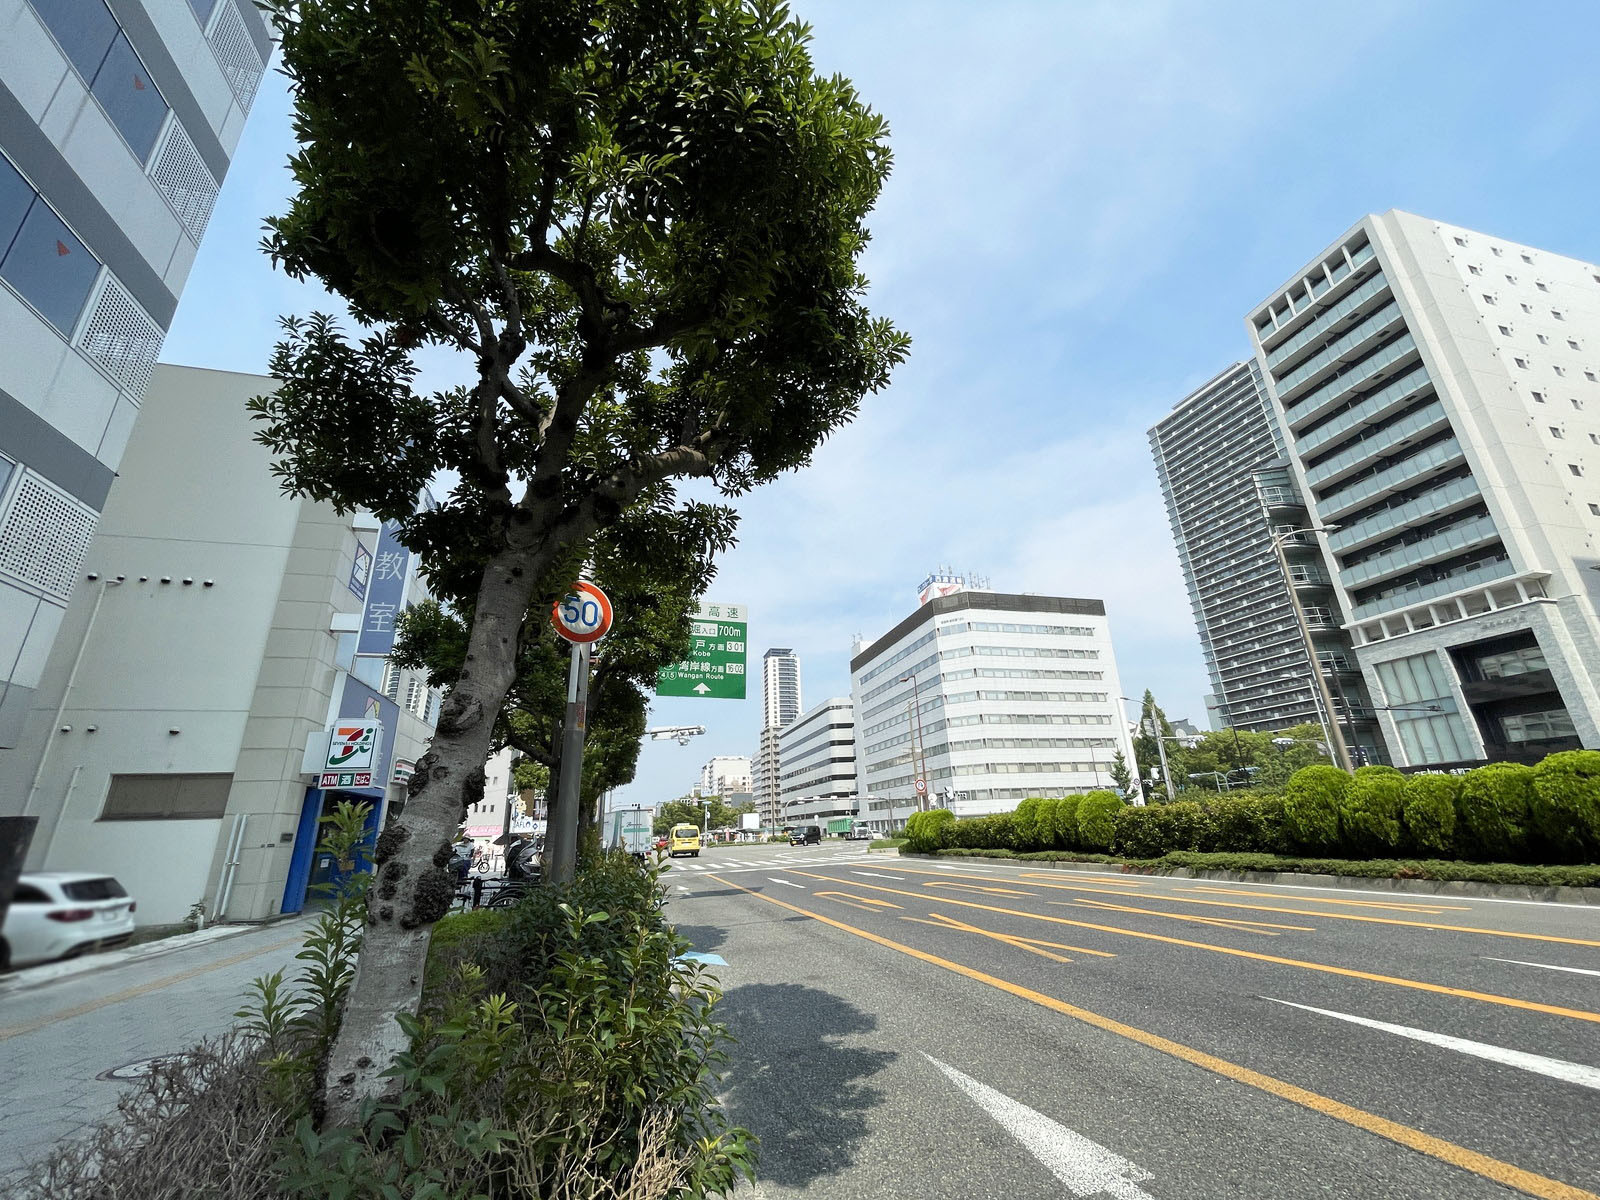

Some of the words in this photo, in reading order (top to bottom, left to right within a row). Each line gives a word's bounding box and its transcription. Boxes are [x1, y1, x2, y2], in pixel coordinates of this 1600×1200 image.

[563, 595, 599, 627] 50
[719, 625, 741, 637] 700m
[677, 671, 704, 679] Wangan
[322, 775, 337, 785] ATM
